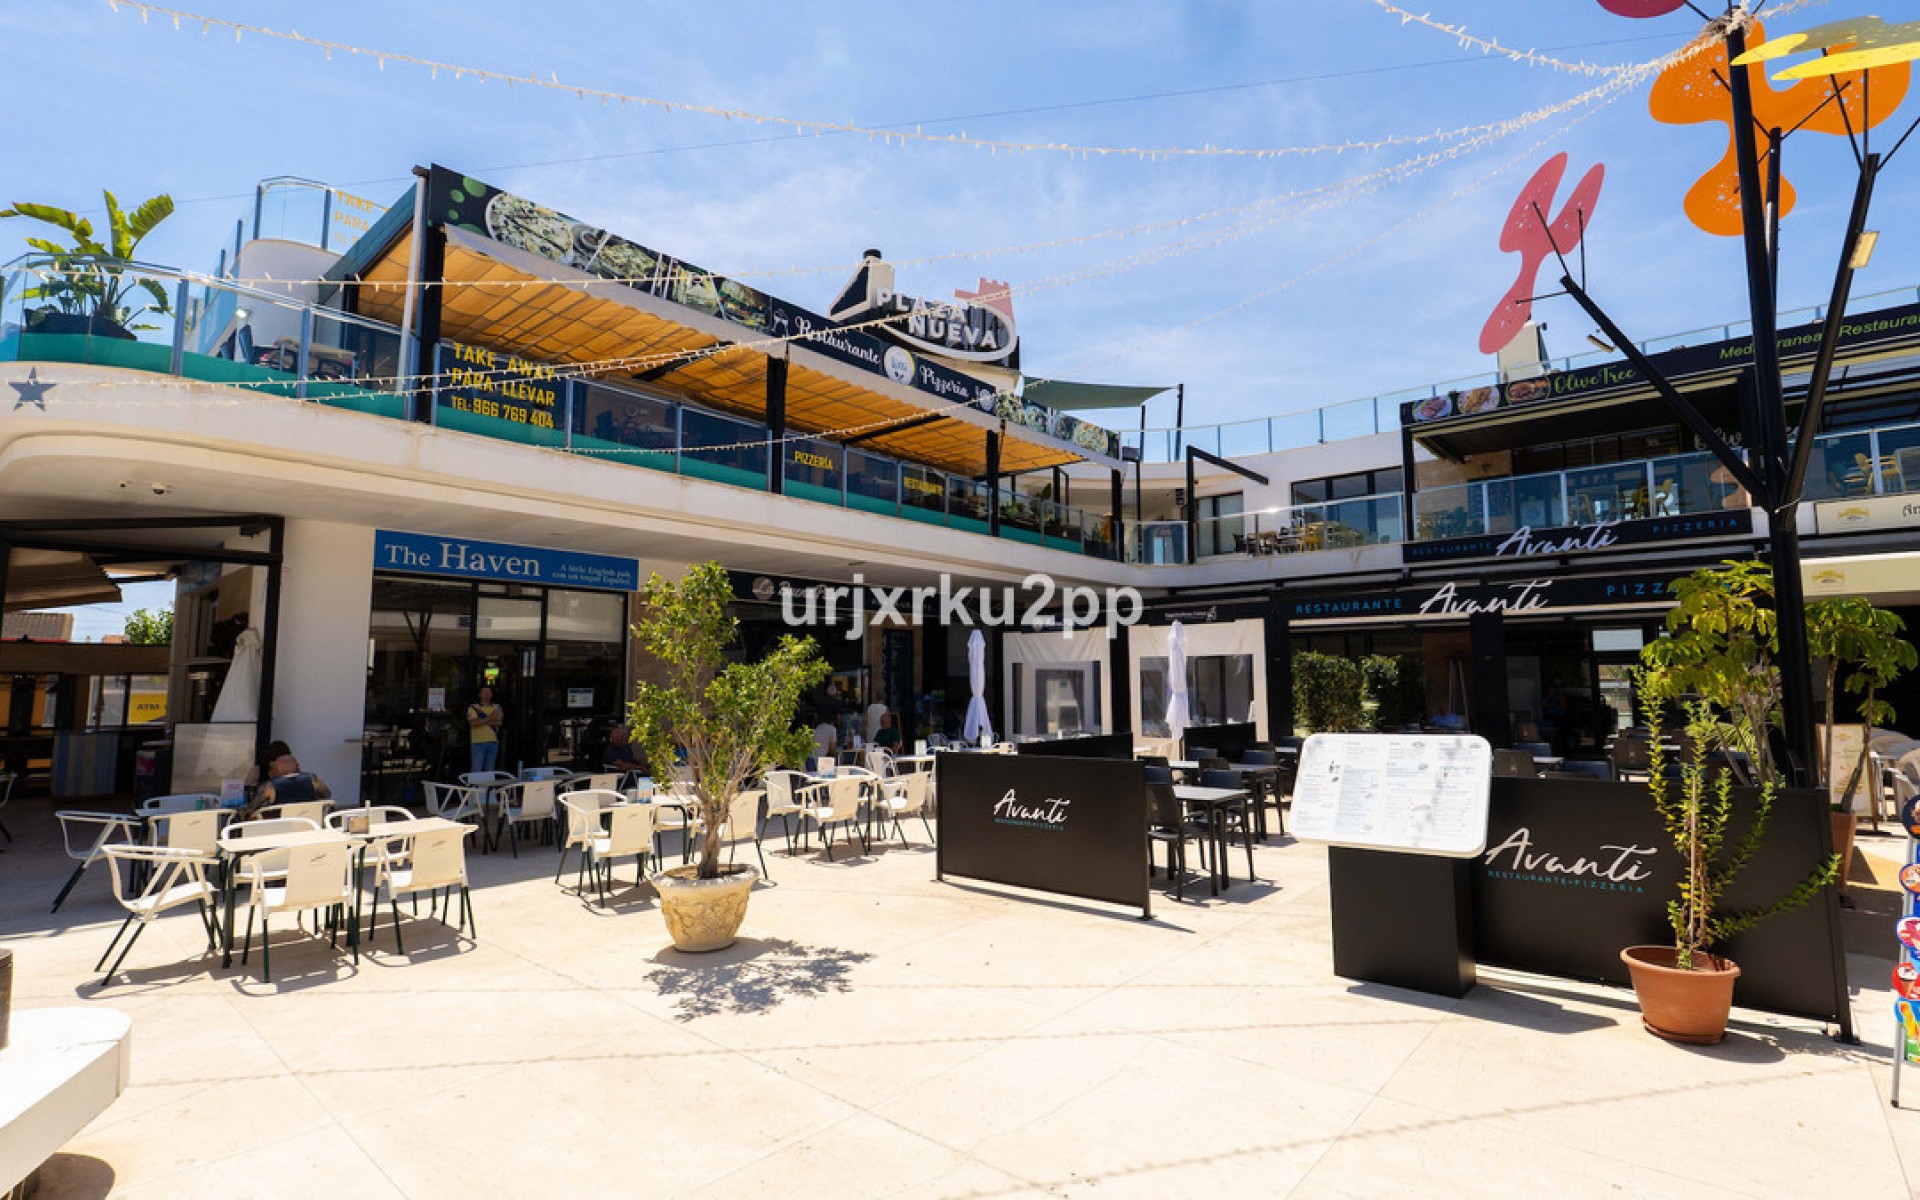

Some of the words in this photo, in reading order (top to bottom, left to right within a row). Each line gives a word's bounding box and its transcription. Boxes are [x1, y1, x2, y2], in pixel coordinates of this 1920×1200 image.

[876, 287, 966, 323] PLAZA
[908, 314, 998, 350] NUEVA
[1719, 332, 1826, 360] Medranea
[1840, 313, 1920, 338] Restaura
[453, 342, 497, 369] TAKE
[507, 355, 555, 382] AWAY
[794, 316, 881, 364] Restaurante
[918, 364, 971, 399] Pizzeria
[451, 367, 494, 392] PARA
[502, 381, 556, 407] LLEVAR
[472, 399, 500, 417] 966
[502, 404, 528, 424] 769
[529, 409, 555, 429] 404
[1495, 518, 1621, 558] Avanti
[1652, 517, 1738, 534] PIZZERIA
[384, 544, 431, 567] The
[438, 541, 541, 577] Haven
[1296, 598, 1402, 615] RESTAURANTE
[1419, 579, 1553, 615] Avanti
[993, 788, 1071, 824] Avanti
[1484, 827, 1658, 883] Avanti
